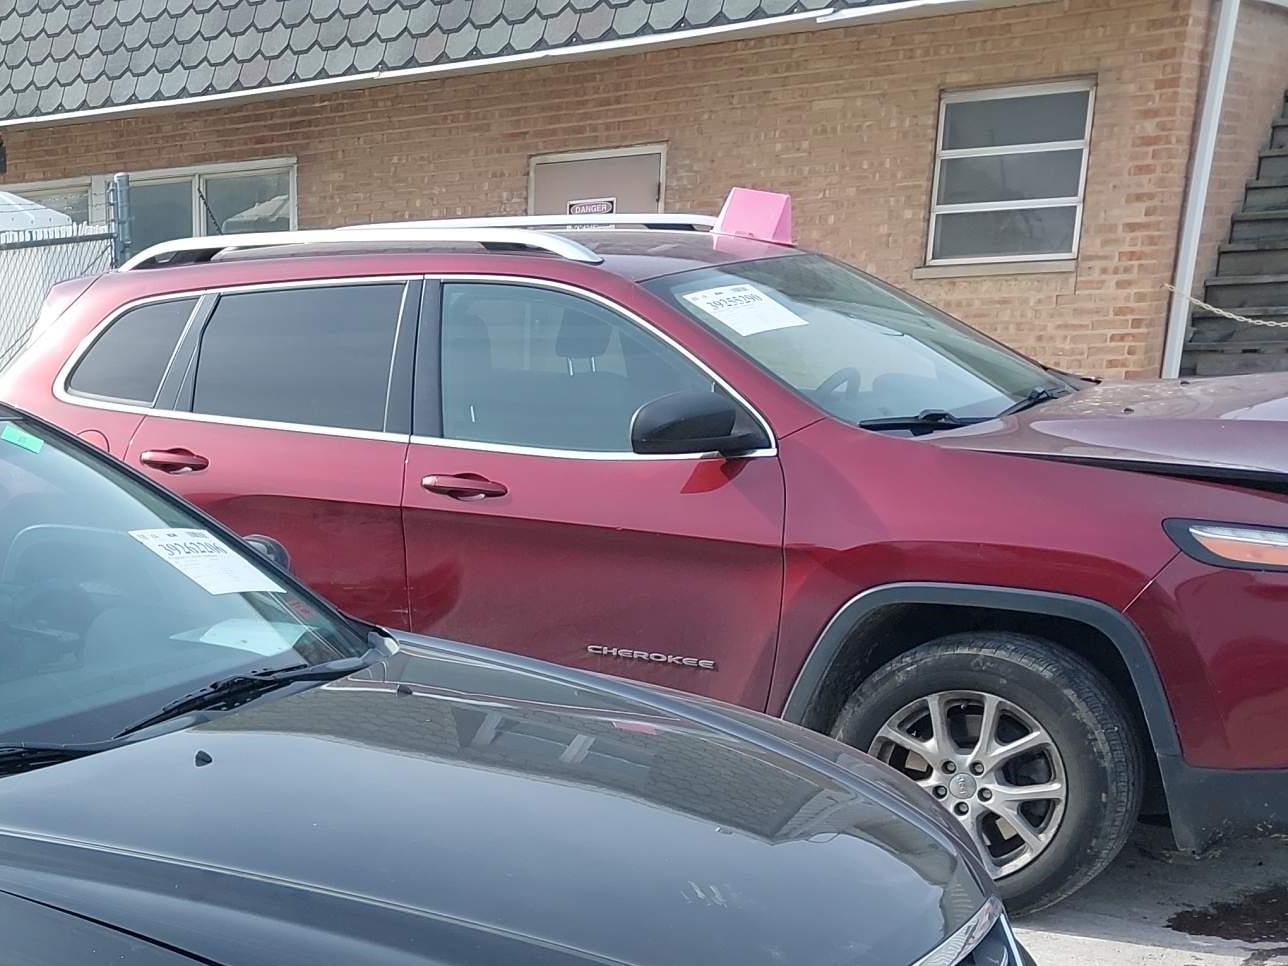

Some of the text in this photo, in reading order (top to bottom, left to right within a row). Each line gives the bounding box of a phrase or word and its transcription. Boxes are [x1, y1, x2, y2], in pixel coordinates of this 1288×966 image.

[575, 204, 607, 213] DANGER
[158, 541, 228, 556] 39262206
[586, 644, 715, 669] CHEROKEE
